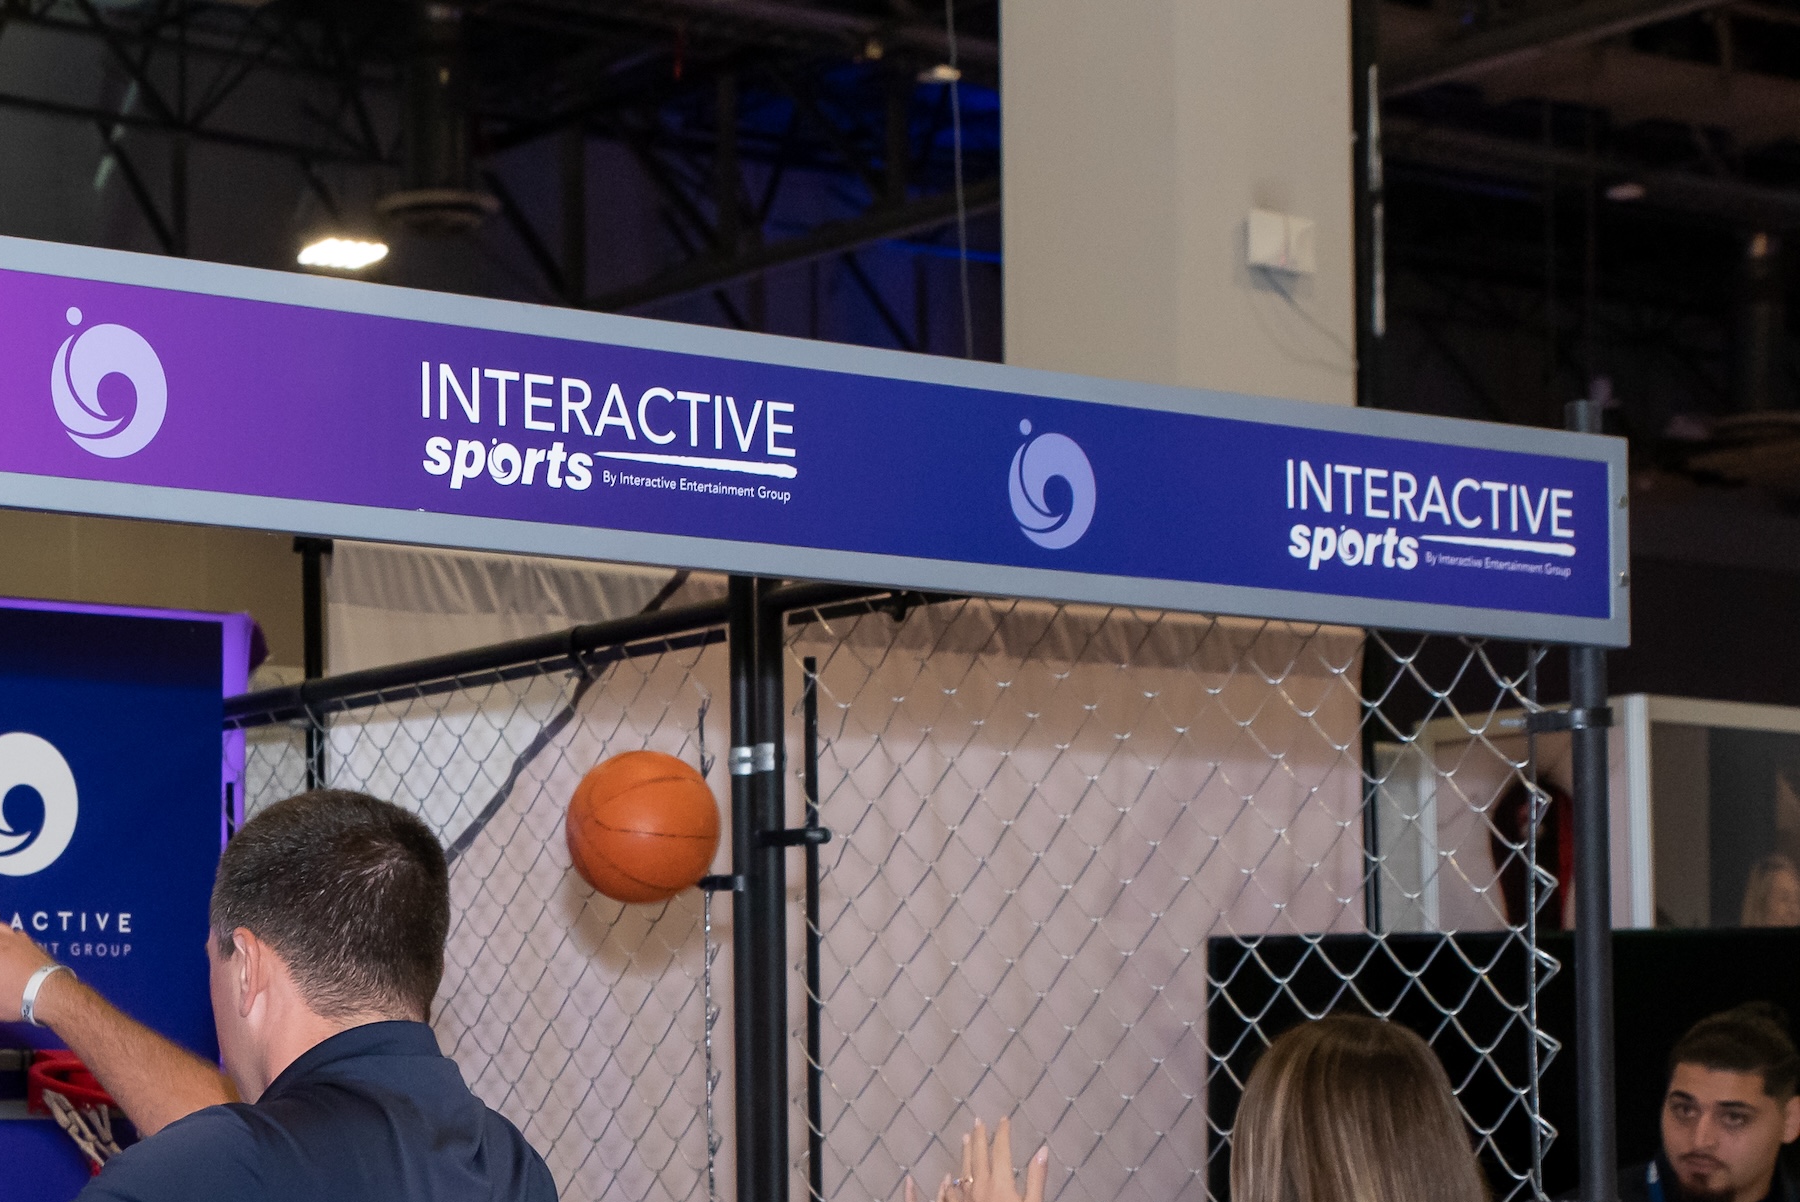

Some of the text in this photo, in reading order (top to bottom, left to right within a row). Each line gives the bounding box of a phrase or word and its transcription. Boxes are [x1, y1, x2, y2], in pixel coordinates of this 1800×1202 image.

[421, 361, 796, 457] INTERACTIVE
[423, 437, 593, 490] sports
[603, 470, 790, 504] By Interactive Entertainment Group
[1286, 459, 1575, 538] INTERACTIVE
[1289, 525, 1418, 570] sports
[1425, 551, 1437, 566] By
[1544, 563, 1571, 577] Group
[71, 942, 132, 957] GROUP
